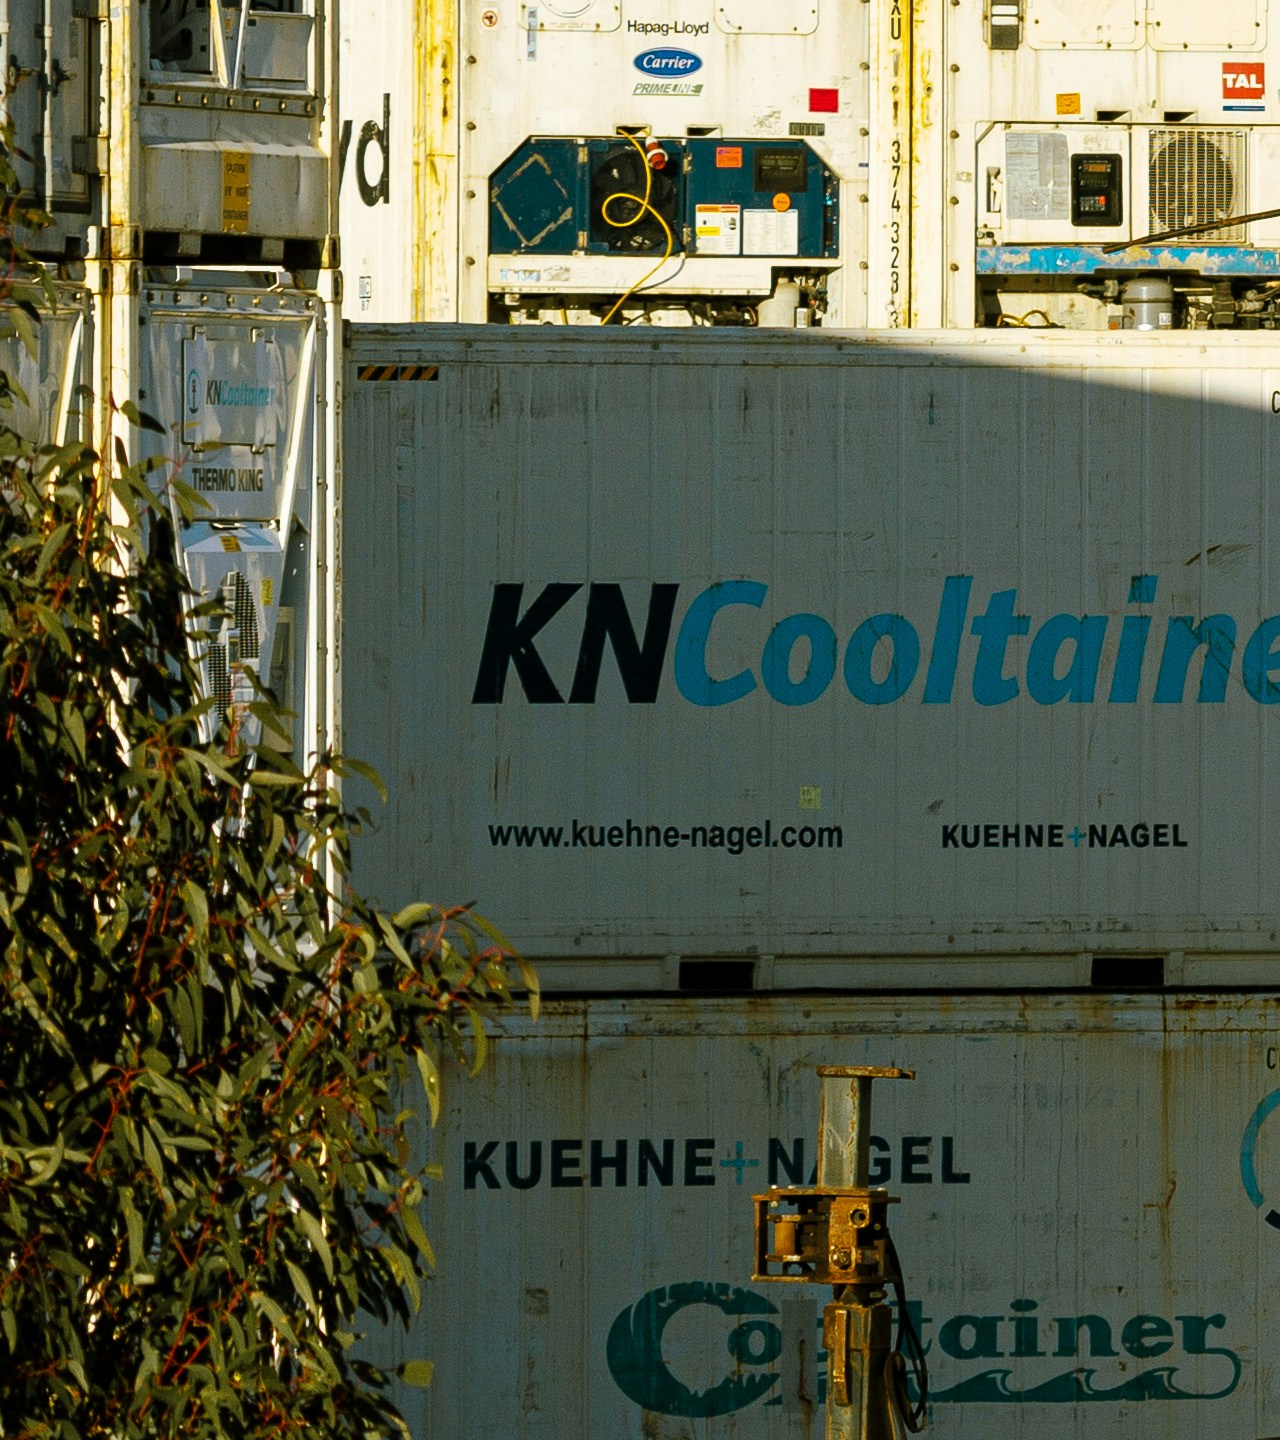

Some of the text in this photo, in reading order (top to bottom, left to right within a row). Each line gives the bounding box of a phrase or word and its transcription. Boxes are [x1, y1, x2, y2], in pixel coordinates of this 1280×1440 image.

[627, 20, 709, 37] Hapag-Lloyd
[643, 55, 694, 70] Carrier
[1223, 73, 1263, 89] TAL
[191, 467, 263, 492] THERMO KING
[487, 819, 843, 855] www.kuehne-nagel.com
[463, 1135, 970, 1190] KUEHNE+NGEL
